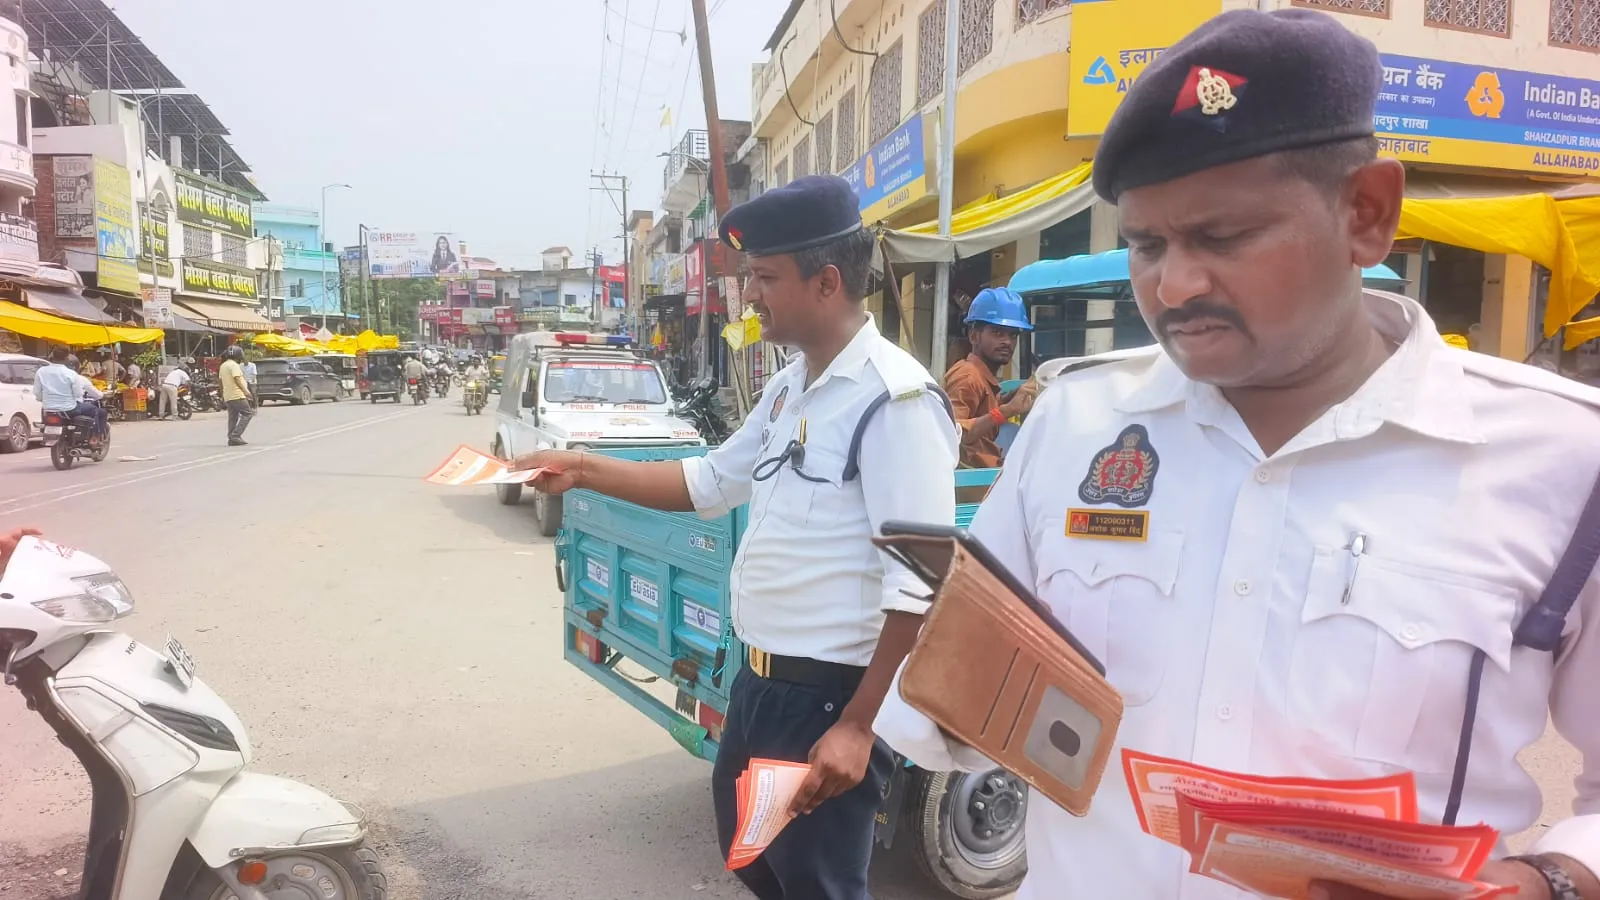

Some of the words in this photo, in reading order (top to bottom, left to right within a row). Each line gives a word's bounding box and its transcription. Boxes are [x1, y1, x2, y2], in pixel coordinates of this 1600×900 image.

[1382, 66, 1412, 87] यन
[1416, 64, 1446, 90] बैंक
[1400, 94, 1410, 104] का
[1524, 80, 1577, 107] Indian
[1580, 87, 1600, 110] Ba
[1401, 117, 1429, 130] शाखा
[1535, 109, 1552, 120] Govt.
[1561, 112, 1577, 122] India
[1577, 114, 1600, 126] Underta
[878, 143, 896, 166] Indian
[894, 127, 911, 154] Bank
[1376, 137, 1431, 156] लाहाबाद
[1524, 130, 1578, 147] SHAHZADPUR
[1579, 136, 1600, 149] BRAN
[1533, 151, 1600, 171] ALLAHABAD
[570, 403, 596, 411] POLICE
